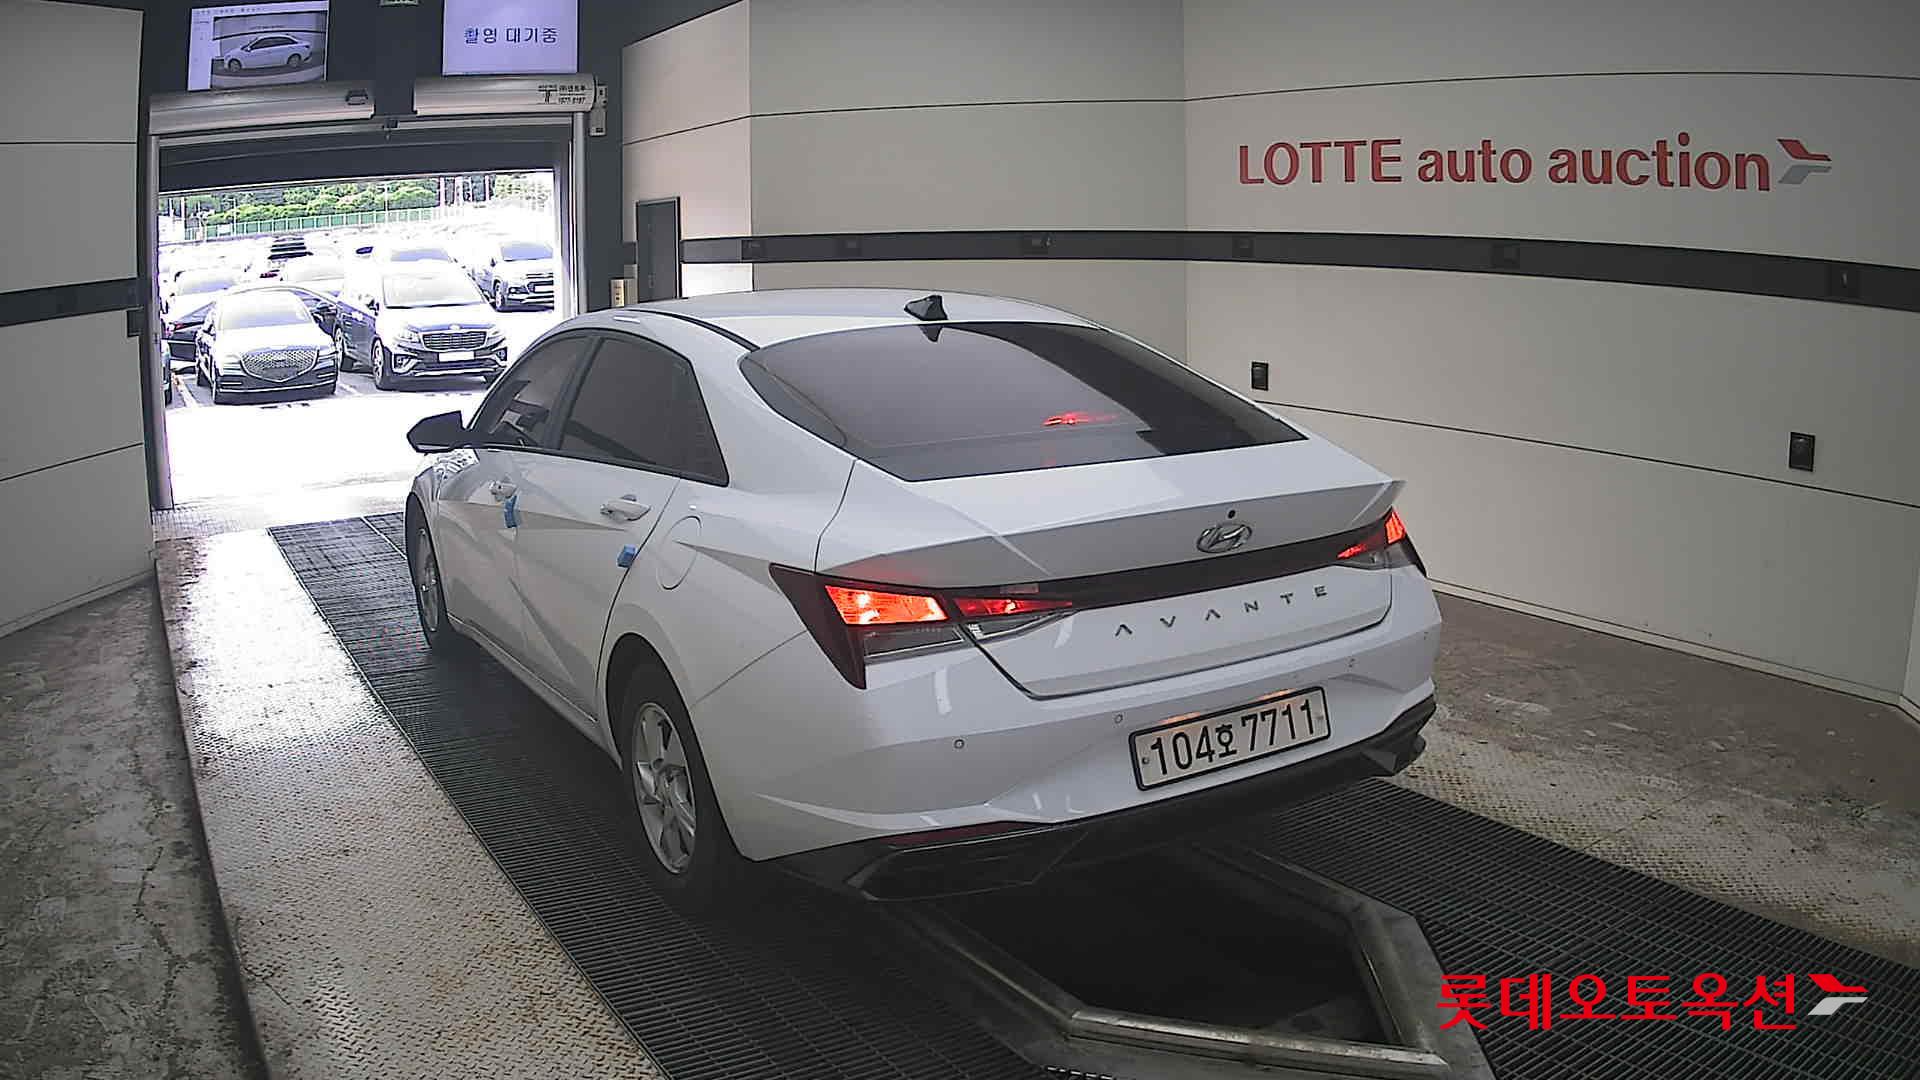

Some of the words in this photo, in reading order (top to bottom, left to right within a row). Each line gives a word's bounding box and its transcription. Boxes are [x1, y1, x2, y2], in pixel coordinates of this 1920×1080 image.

[464, 27, 498, 45] 촬영
[505, 27, 559, 45] 대기중
[1238, 138, 1402, 185] LOTTE
[1416, 139, 1533, 184] auto
[1547, 131, 1771, 192] auction
[1114, 585, 1328, 637] AVANTE
